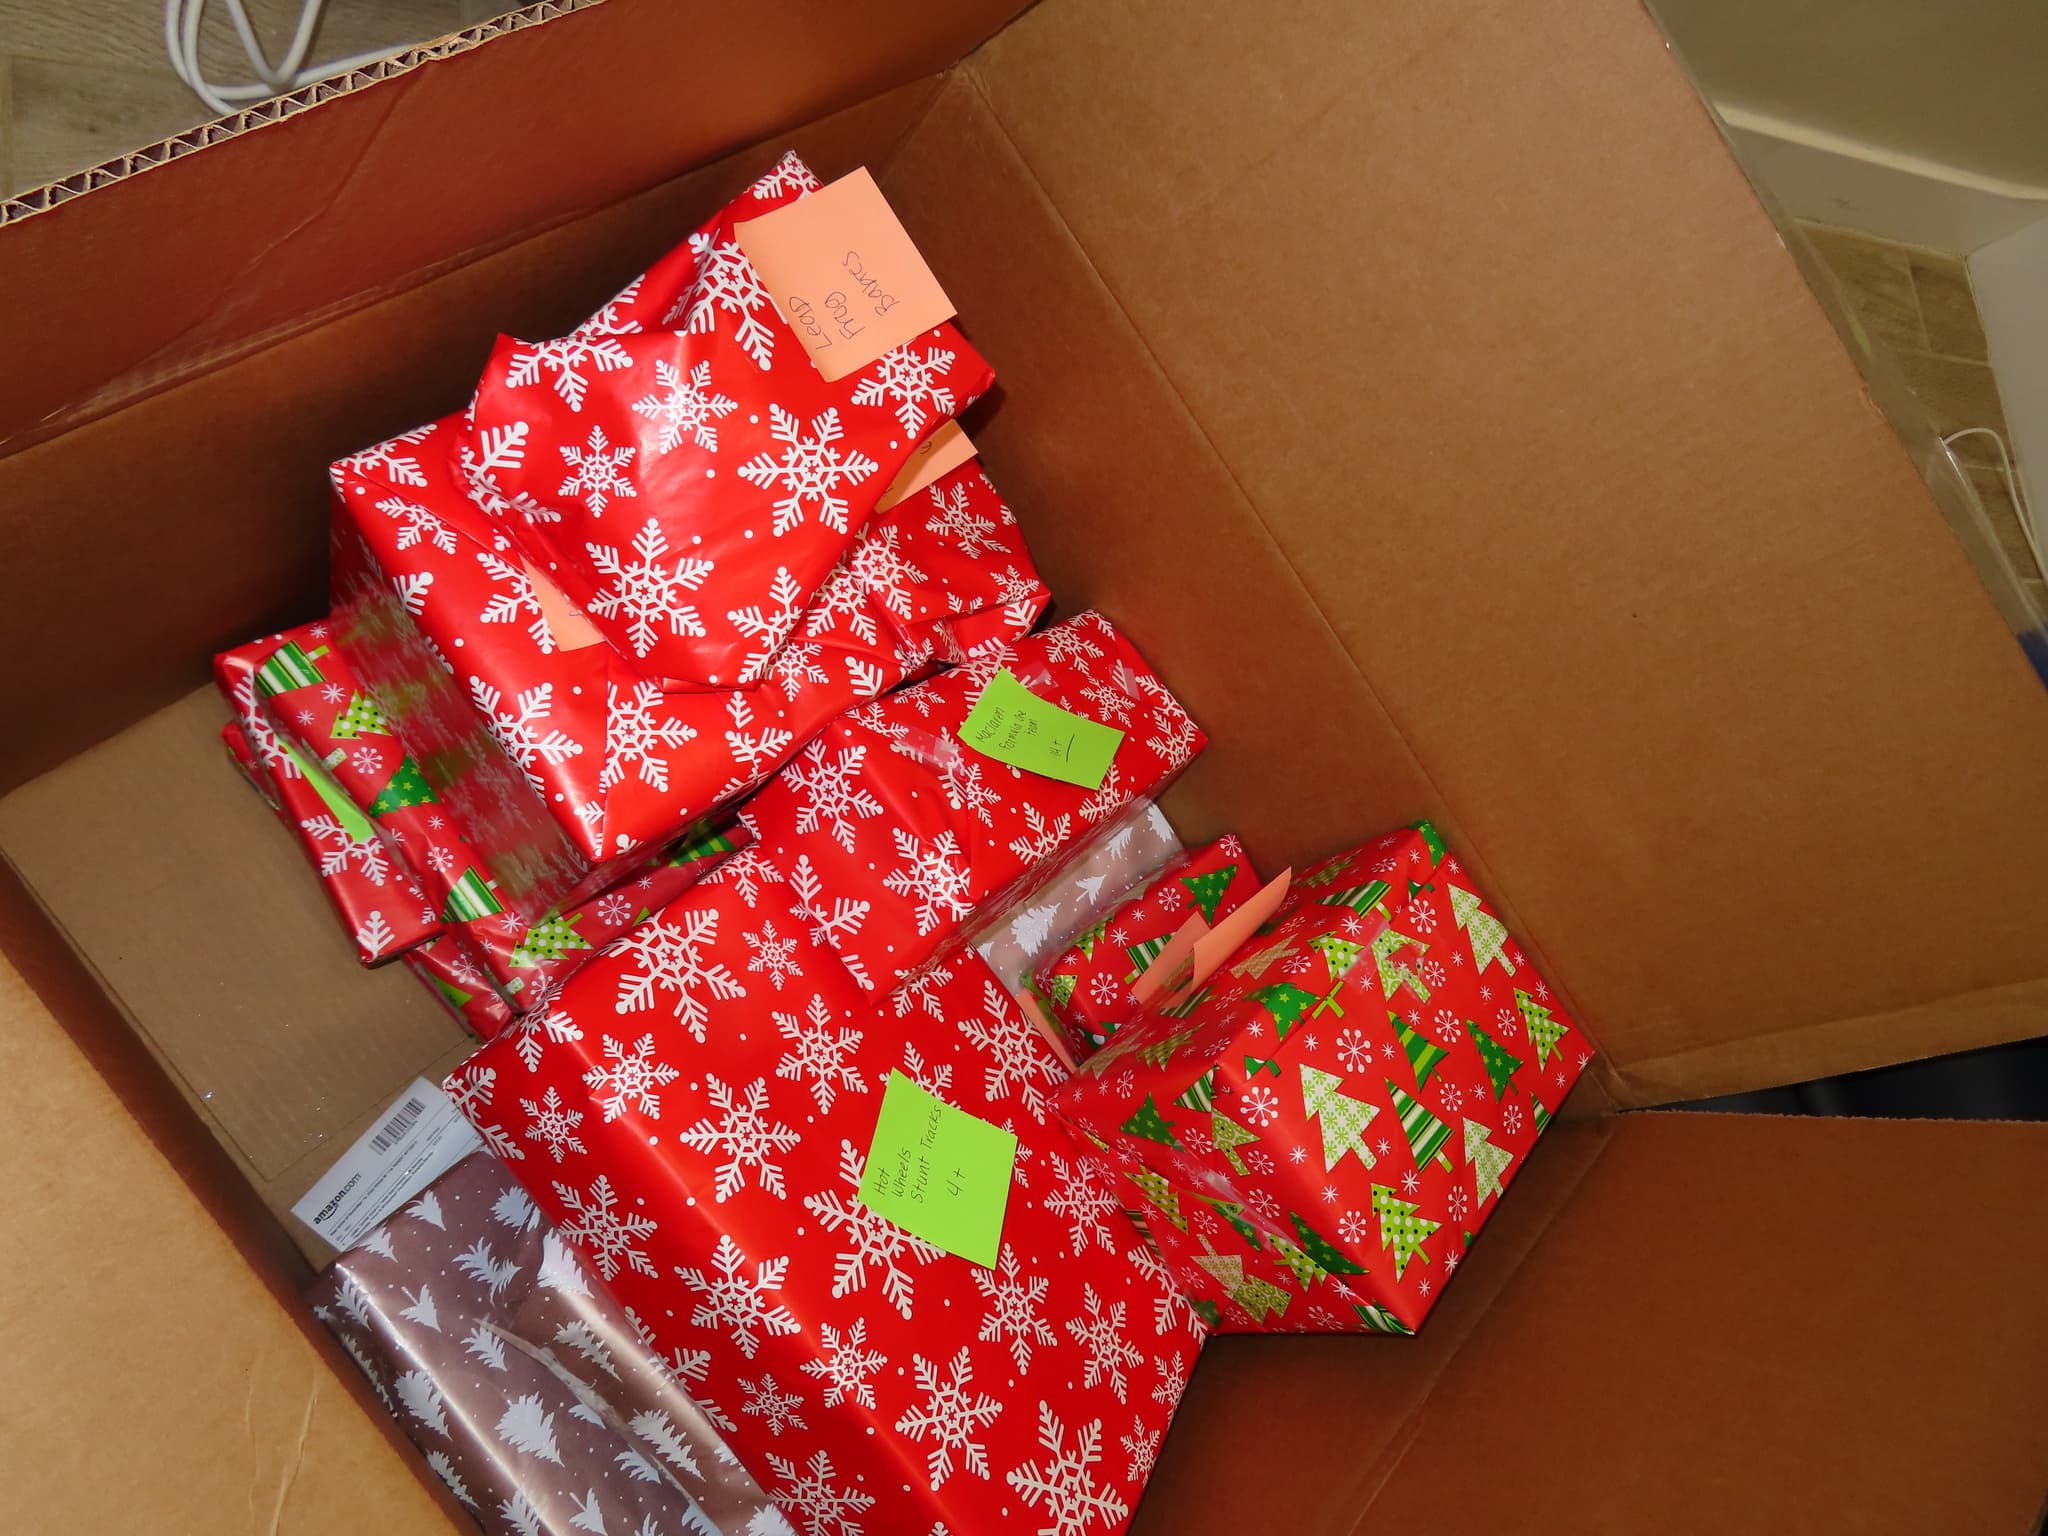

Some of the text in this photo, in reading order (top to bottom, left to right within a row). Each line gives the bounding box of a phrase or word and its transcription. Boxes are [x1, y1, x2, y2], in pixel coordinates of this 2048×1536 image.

[891, 1147, 912, 1198] Wheels
[910, 1104, 942, 1204] Stunt Tracks
[312, 1171, 363, 1225] amazon.com
[873, 1167, 891, 1196] Hot
